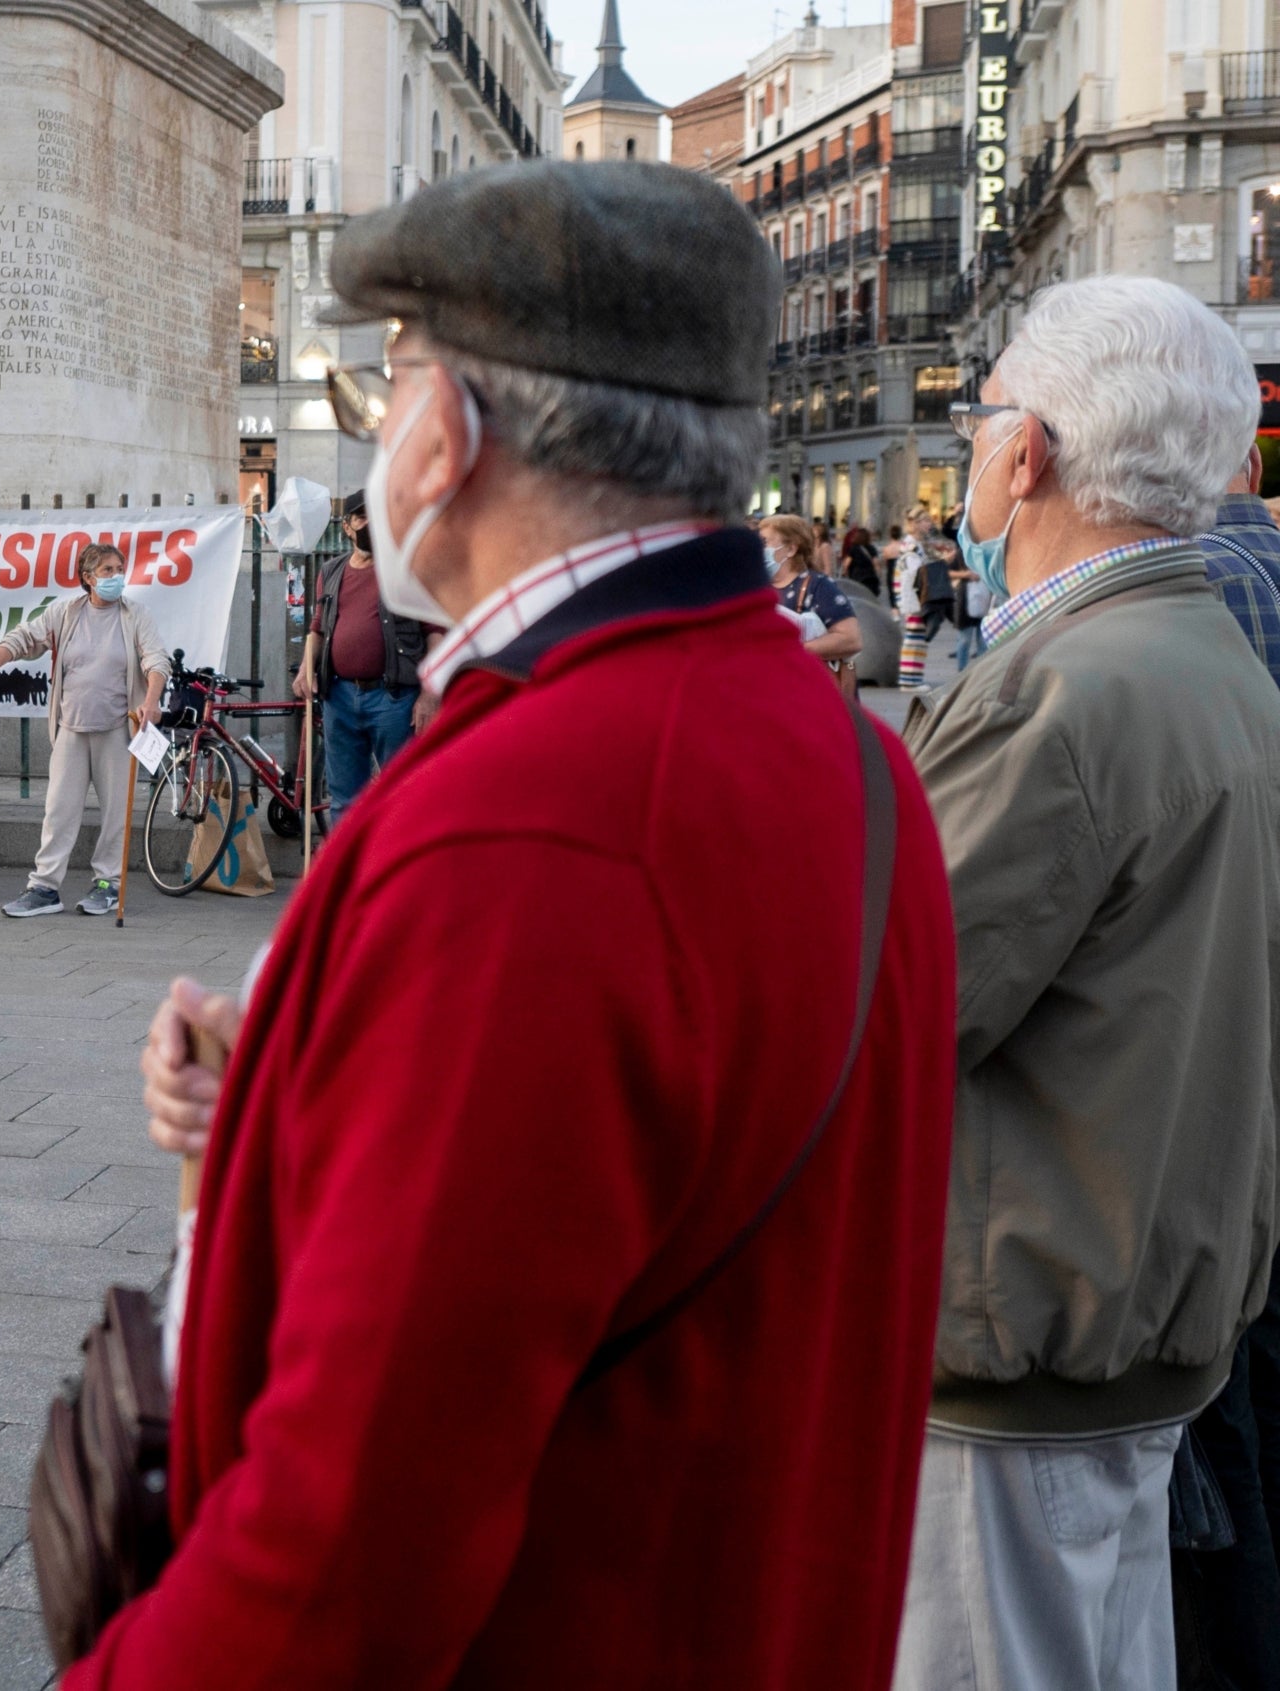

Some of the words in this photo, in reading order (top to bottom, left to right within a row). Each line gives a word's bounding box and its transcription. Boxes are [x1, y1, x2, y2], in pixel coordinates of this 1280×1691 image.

[977, 55, 1007, 231] EUROPA
[18, 206, 26, 217] E
[38, 207, 72, 224] ISABEL
[0, 221, 15, 232] VI
[27, 222, 44, 233] EN
[15, 236, 36, 249] LA
[1, 252, 16, 264] EL
[21, 330, 48, 343] VNA
[26, 345, 76, 363] TRAZADO
